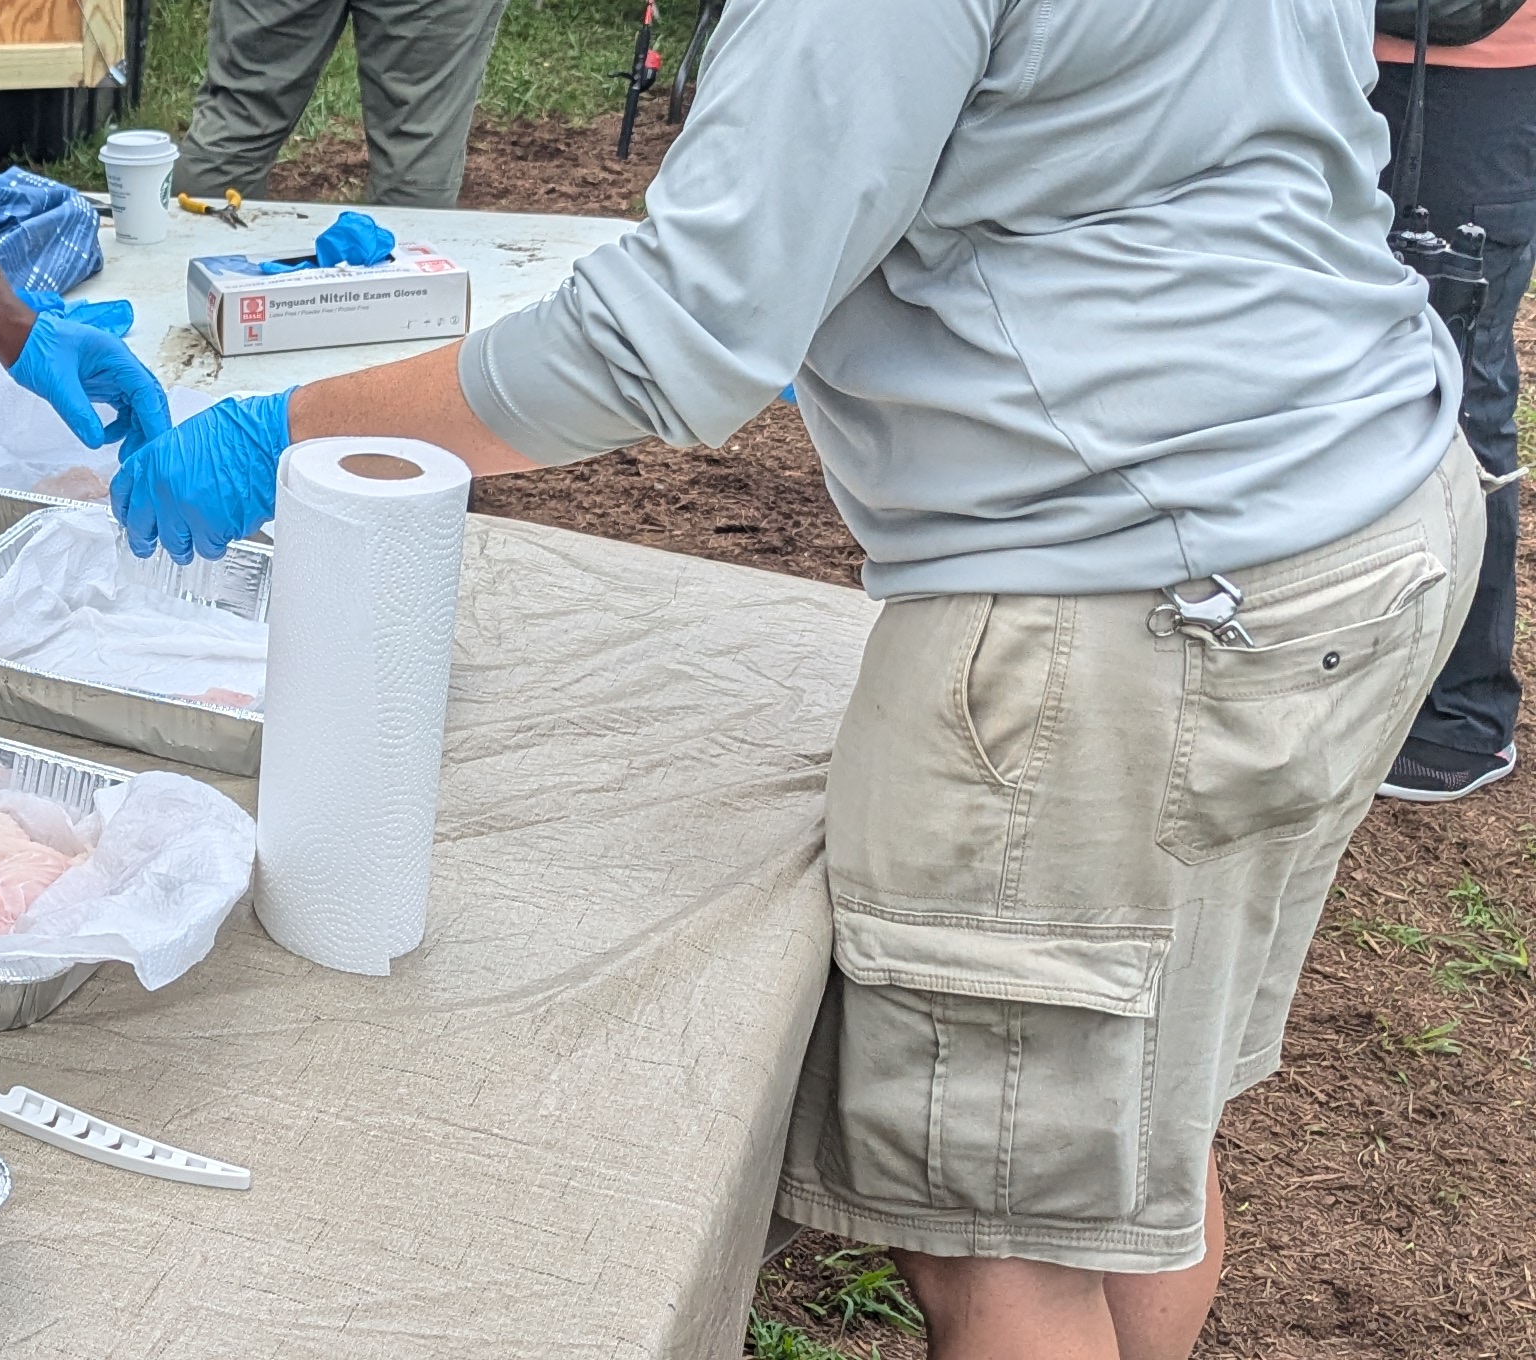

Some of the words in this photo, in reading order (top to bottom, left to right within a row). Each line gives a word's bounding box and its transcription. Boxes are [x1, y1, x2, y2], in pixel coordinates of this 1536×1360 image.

[269, 297, 316, 310] Synguard
[319, 291, 360, 304] Nitrile
[363, 291, 391, 301] Exam
[393, 288, 428, 298] Gloves
[248, 326, 259, 337] L
